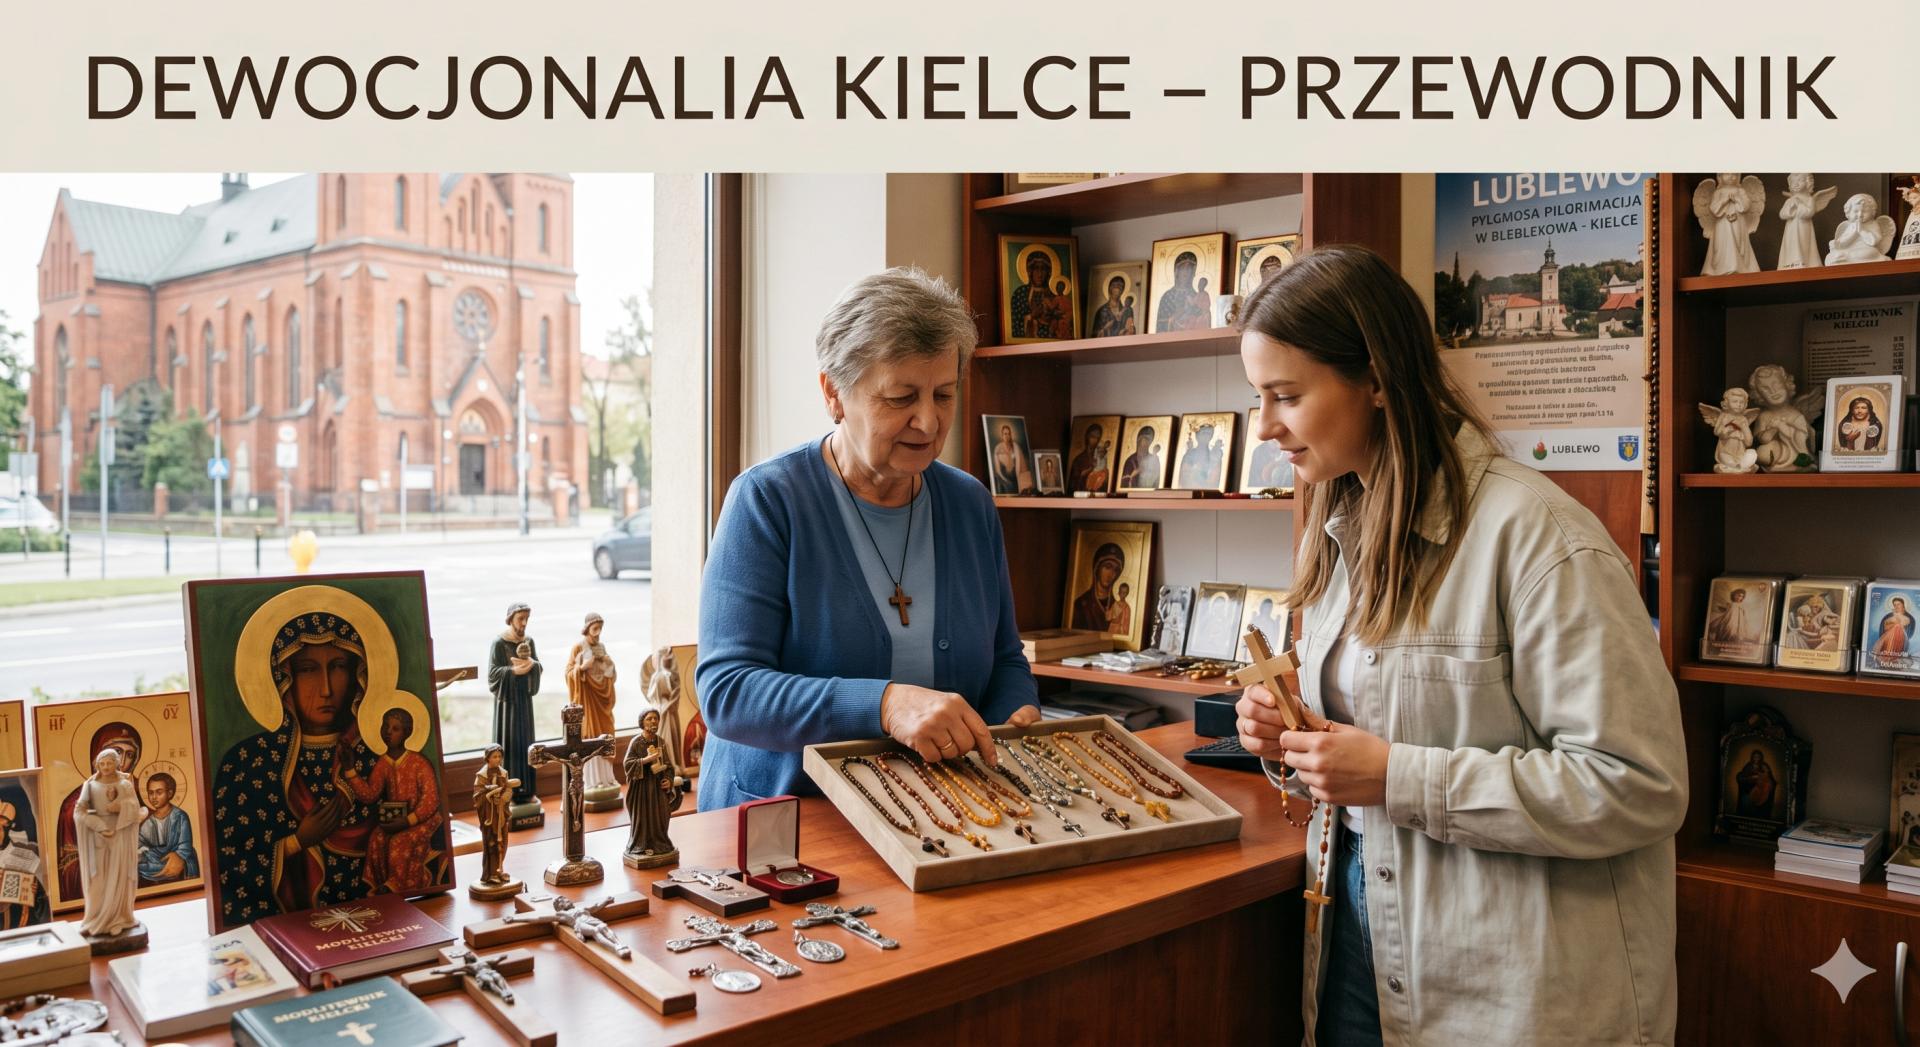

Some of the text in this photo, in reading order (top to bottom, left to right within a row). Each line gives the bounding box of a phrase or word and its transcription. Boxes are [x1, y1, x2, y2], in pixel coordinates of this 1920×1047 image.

[1471, 194, 1642, 227] PYLGMOSA PILORIMACIJA
[1475, 232, 1488, 244] W
[1590, 213, 1638, 230] KIELCE
[1552, 444, 1600, 454] LUBLEWO
[315, 923, 424, 951] MODLITEWNIK
[348, 934, 407, 951] KIELCKI
[272, 990, 388, 1024] MODLITEWNIK
